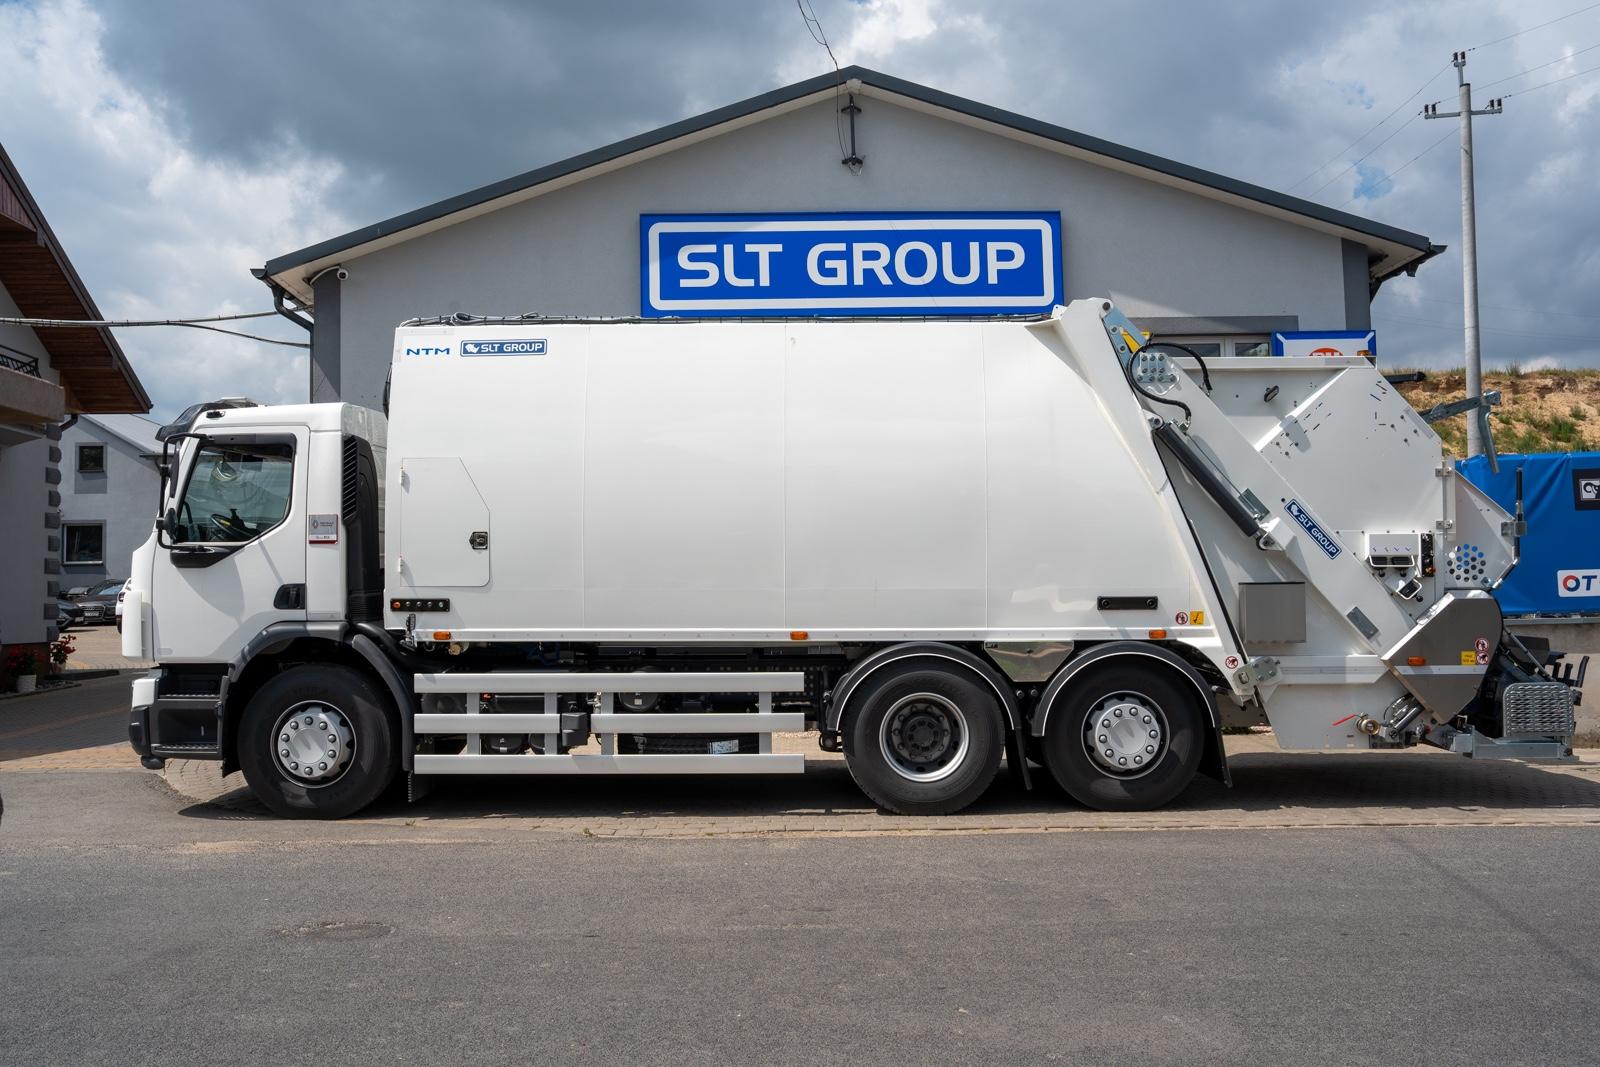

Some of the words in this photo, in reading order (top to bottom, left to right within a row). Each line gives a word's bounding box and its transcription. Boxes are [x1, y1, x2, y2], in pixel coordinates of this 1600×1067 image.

[677, 243, 783, 287] SLT
[806, 241, 1026, 286] GROUP
[406, 348, 450, 356] NTM
[480, 343, 501, 353] SLT
[503, 342, 543, 352] GROUP
[1298, 513, 1313, 528] SLT
[1311, 527, 1337, 553] GROUP
[1562, 574, 1600, 592] OT
